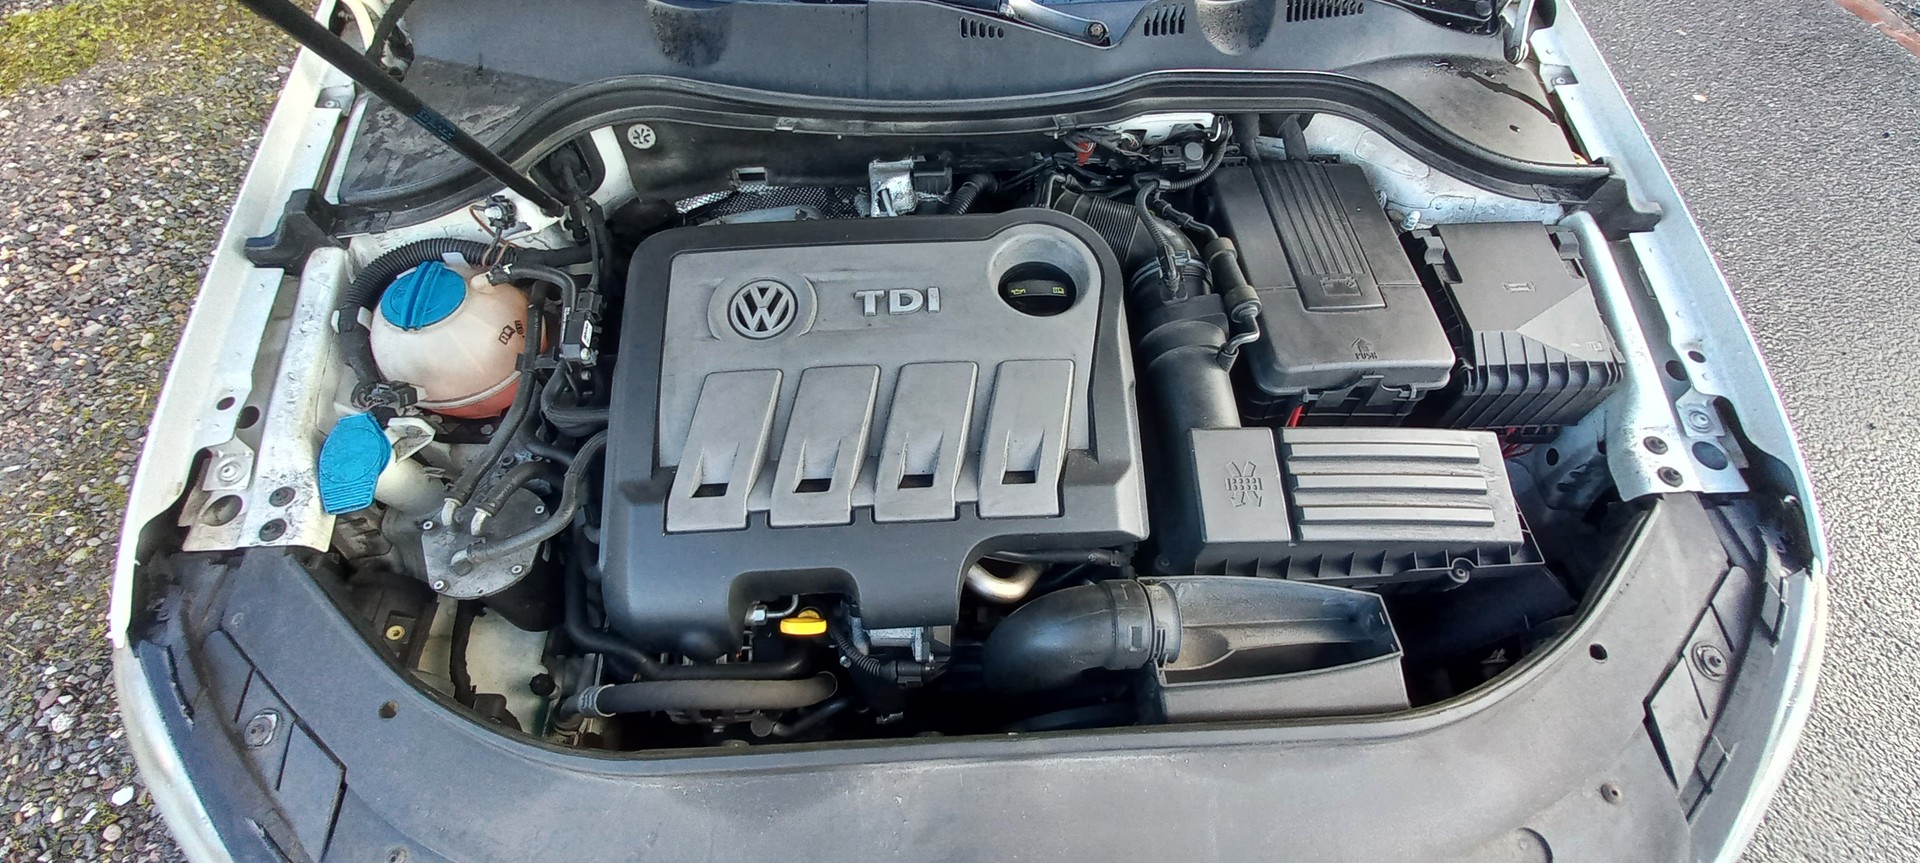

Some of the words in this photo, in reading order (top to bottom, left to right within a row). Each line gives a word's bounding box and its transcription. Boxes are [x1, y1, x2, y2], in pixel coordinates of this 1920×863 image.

[730, 279, 796, 339] VW
[854, 287, 941, 316] TDI
[1355, 352, 1378, 360] PUSH
